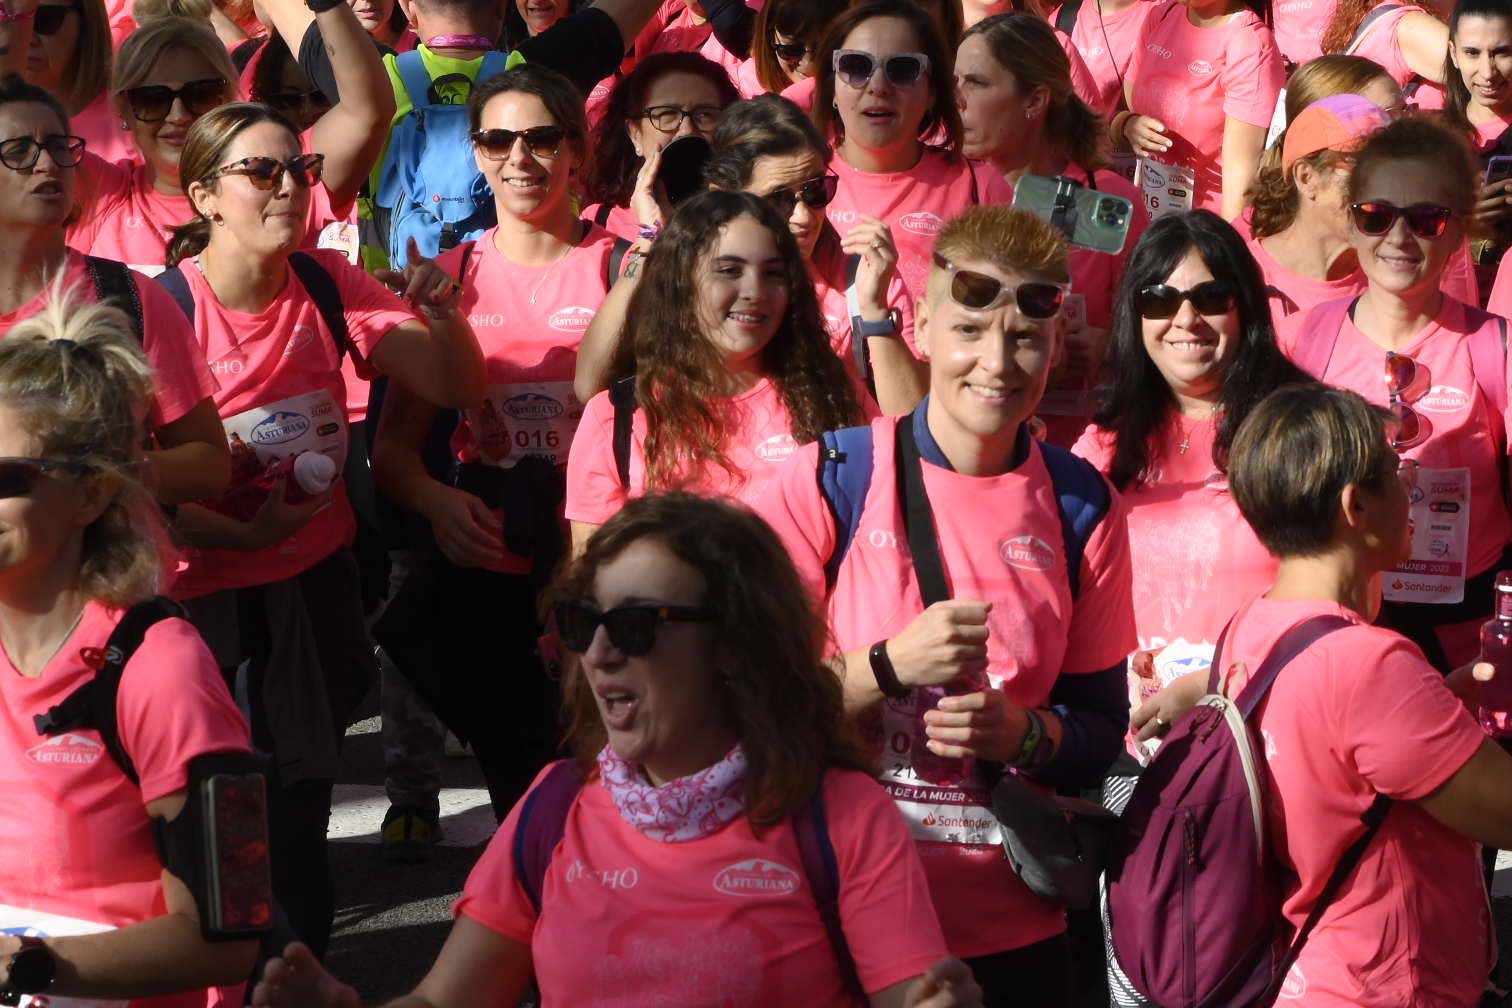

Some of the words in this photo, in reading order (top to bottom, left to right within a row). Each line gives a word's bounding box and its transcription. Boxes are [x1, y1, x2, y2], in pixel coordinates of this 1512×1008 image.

[470, 314, 504, 328] SHO
[257, 419, 307, 442] ASTURIANA
[515, 430, 560, 448] 016
[1404, 581, 1452, 593] Santander
[894, 787, 911, 798] DE
[913, 789, 927, 799] LA
[929, 791, 966, 802] MUJER
[938, 815, 992, 829] Santander
[720, 874, 794, 890] ASTURIANA
